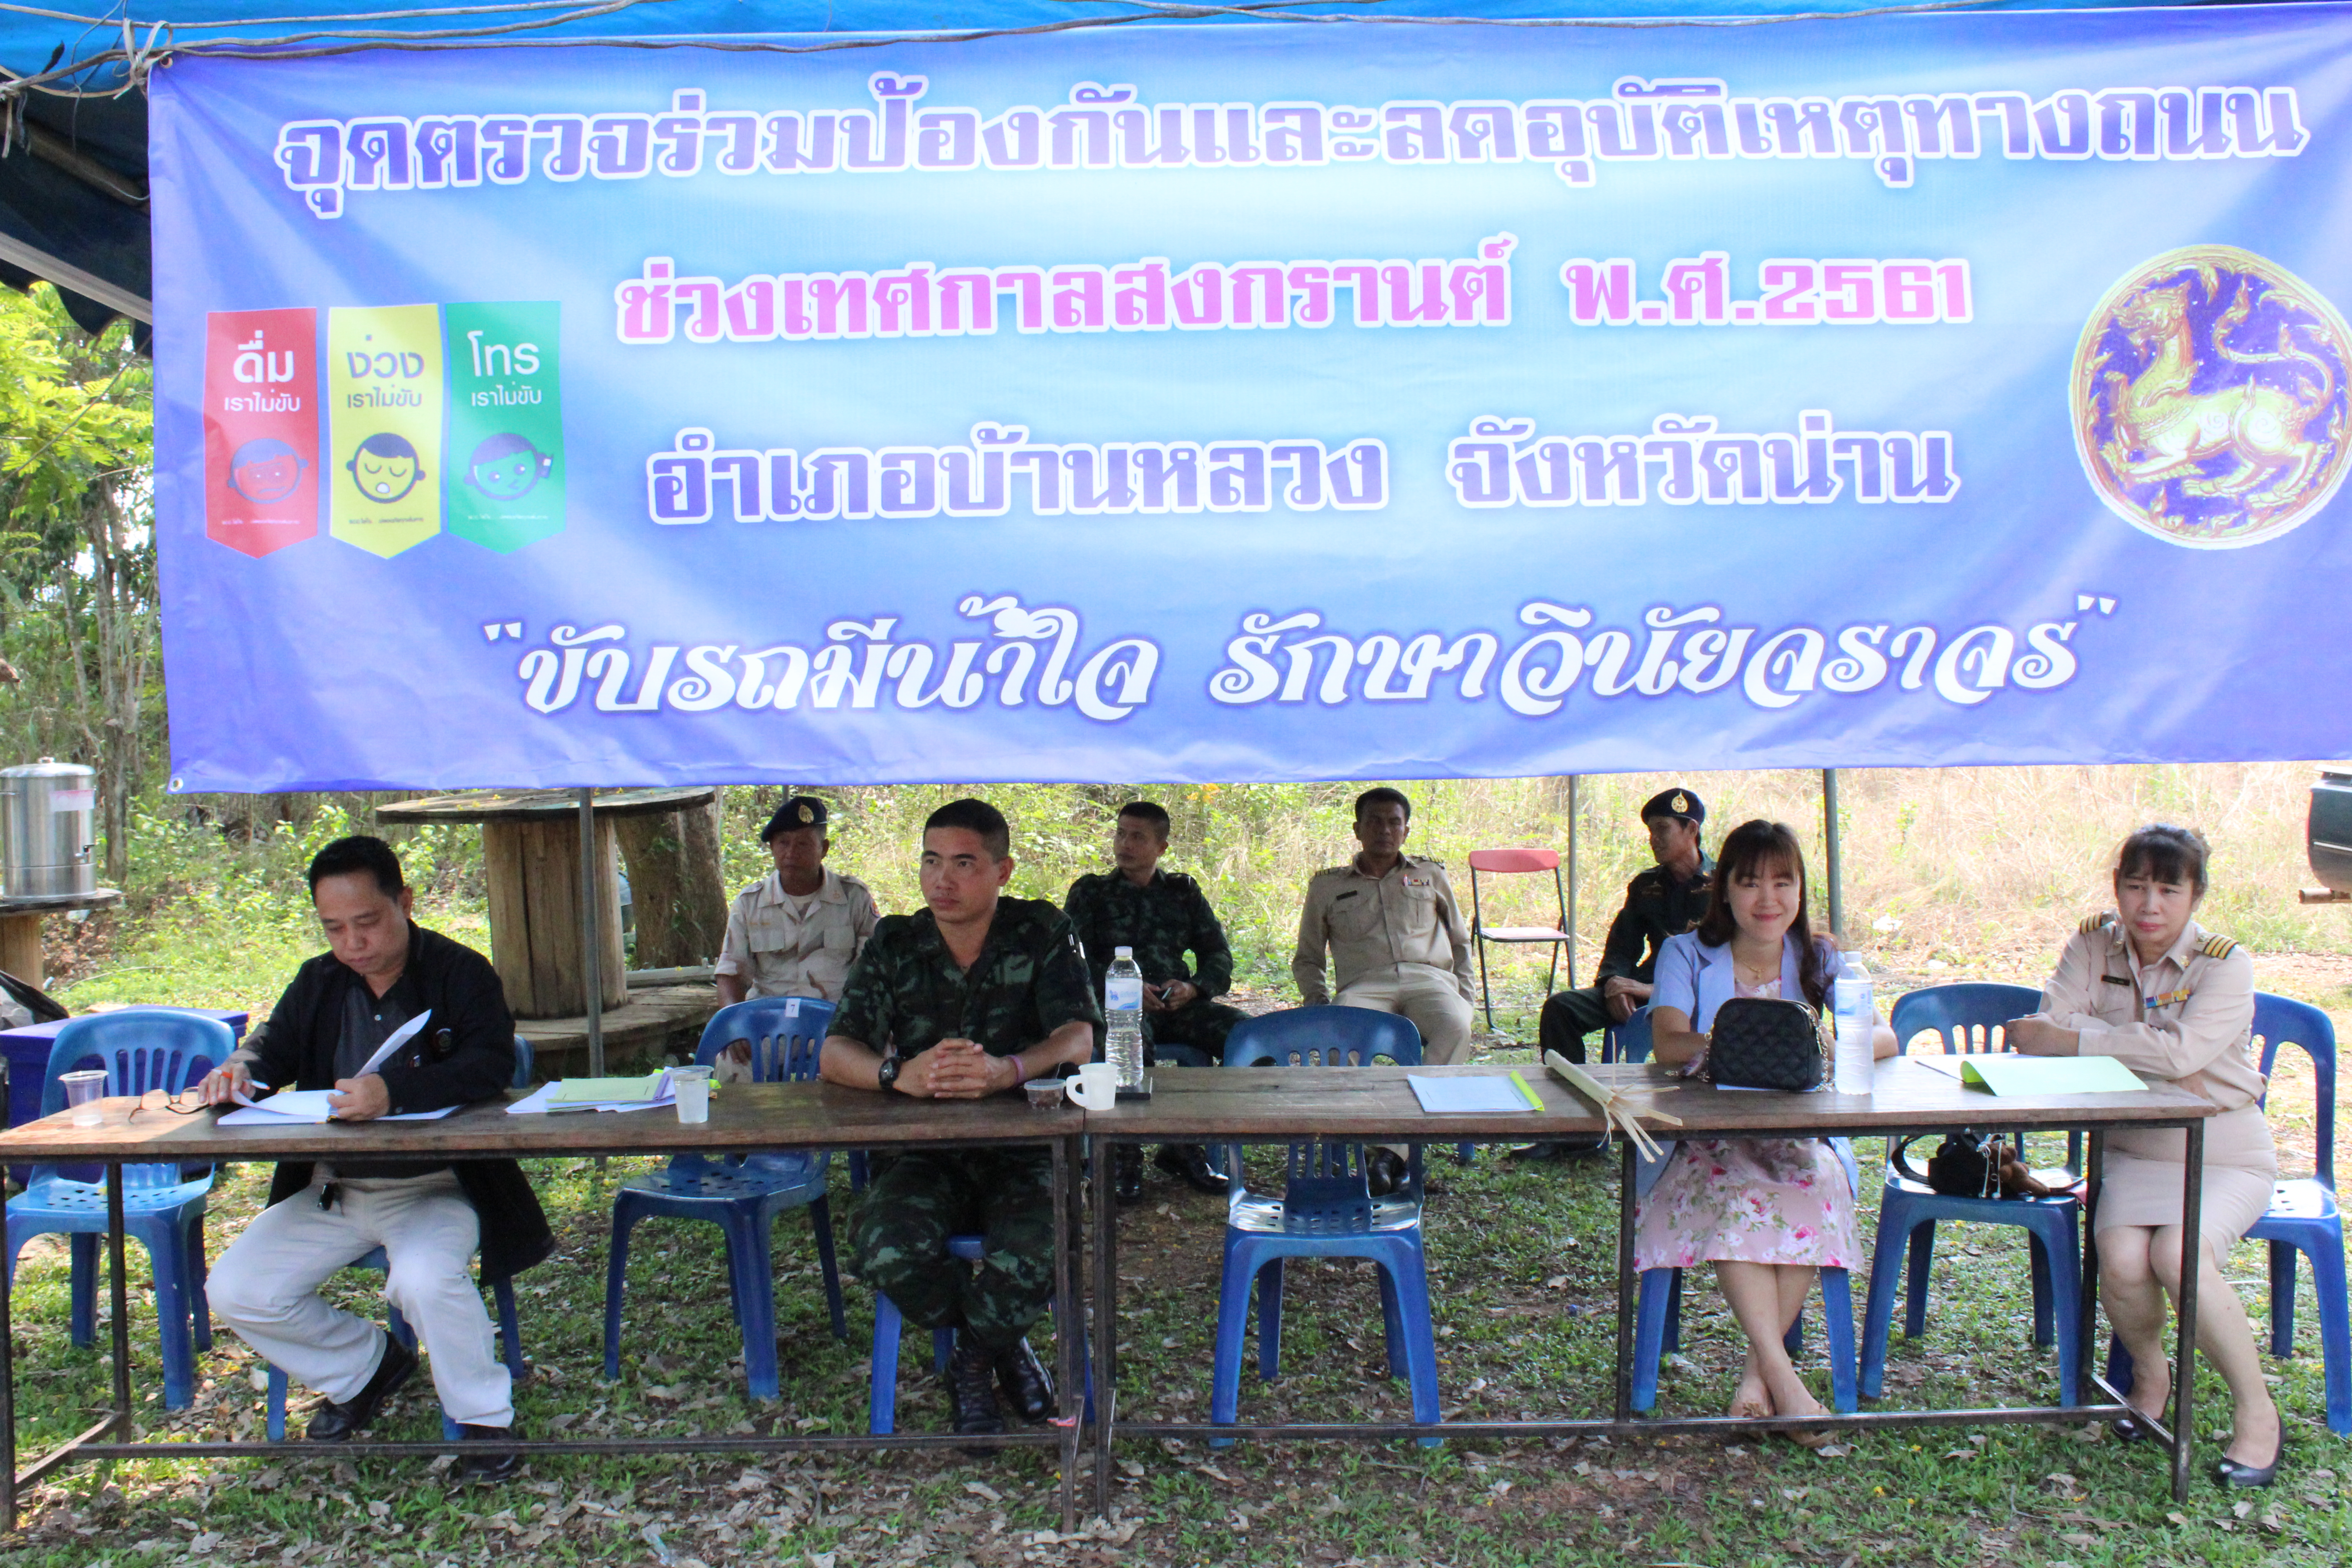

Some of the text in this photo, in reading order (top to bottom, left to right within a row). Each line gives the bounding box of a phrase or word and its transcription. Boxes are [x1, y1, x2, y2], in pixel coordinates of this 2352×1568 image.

[276, 71, 2308, 219] จุดตรวจร่วมป้องกันและลดอุบัติเหตุทางถนน
[617, 232, 1974, 343] ช่วงเทศกาลสงกรานต์ พ.ศ.2561
[233, 330, 294, 384] ดื่ม
[347, 335, 424, 379] ง่วง
[467, 331, 540, 377] โทร
[224, 389, 301, 413] เราไม่ขับ
[347, 384, 422, 408] เราไม่ขับ
[471, 381, 542, 407] เราไม่ขับ
[647, 409, 1961, 525] อำเภอบ้านหลวง จังหวัดน่าน
[791, 1004, 795, 1013] 7
